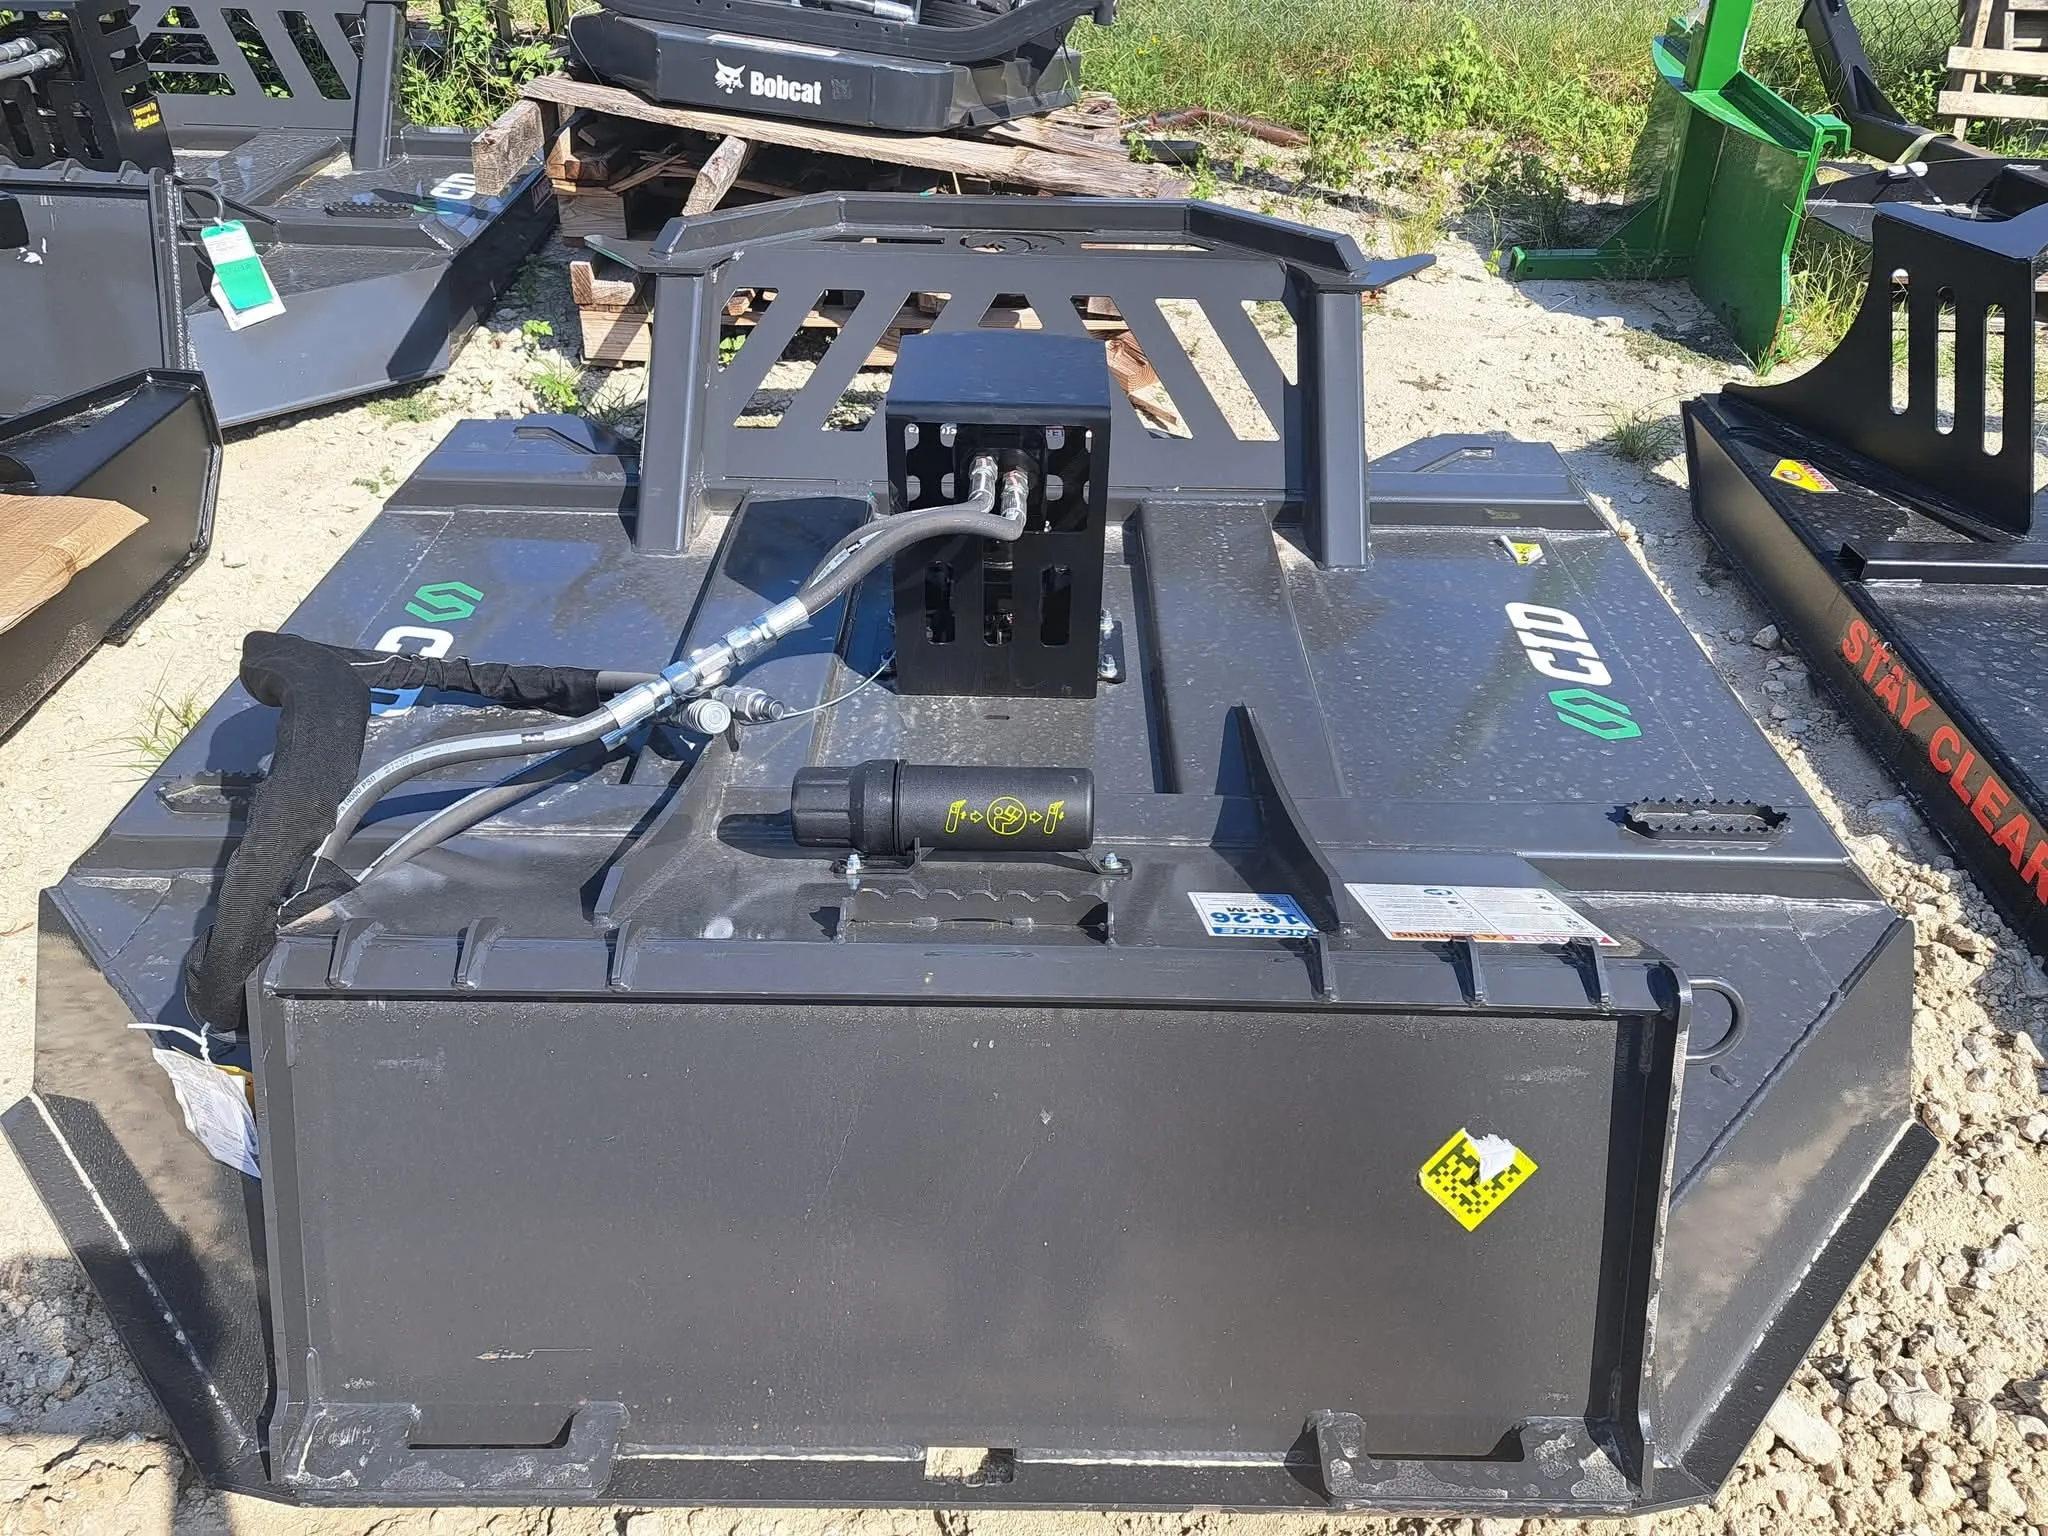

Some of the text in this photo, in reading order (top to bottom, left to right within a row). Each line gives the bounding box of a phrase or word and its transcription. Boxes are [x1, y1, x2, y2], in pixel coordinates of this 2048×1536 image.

[750, 70, 822, 105] Bobcat
[1505, 602, 1613, 686] CID
[1842, 619, 1930, 730] STAY
[1210, 912, 1300, 925] 16-26
[1226, 906, 1277, 914] GPM
[1220, 927, 1308, 936] NOTICE
